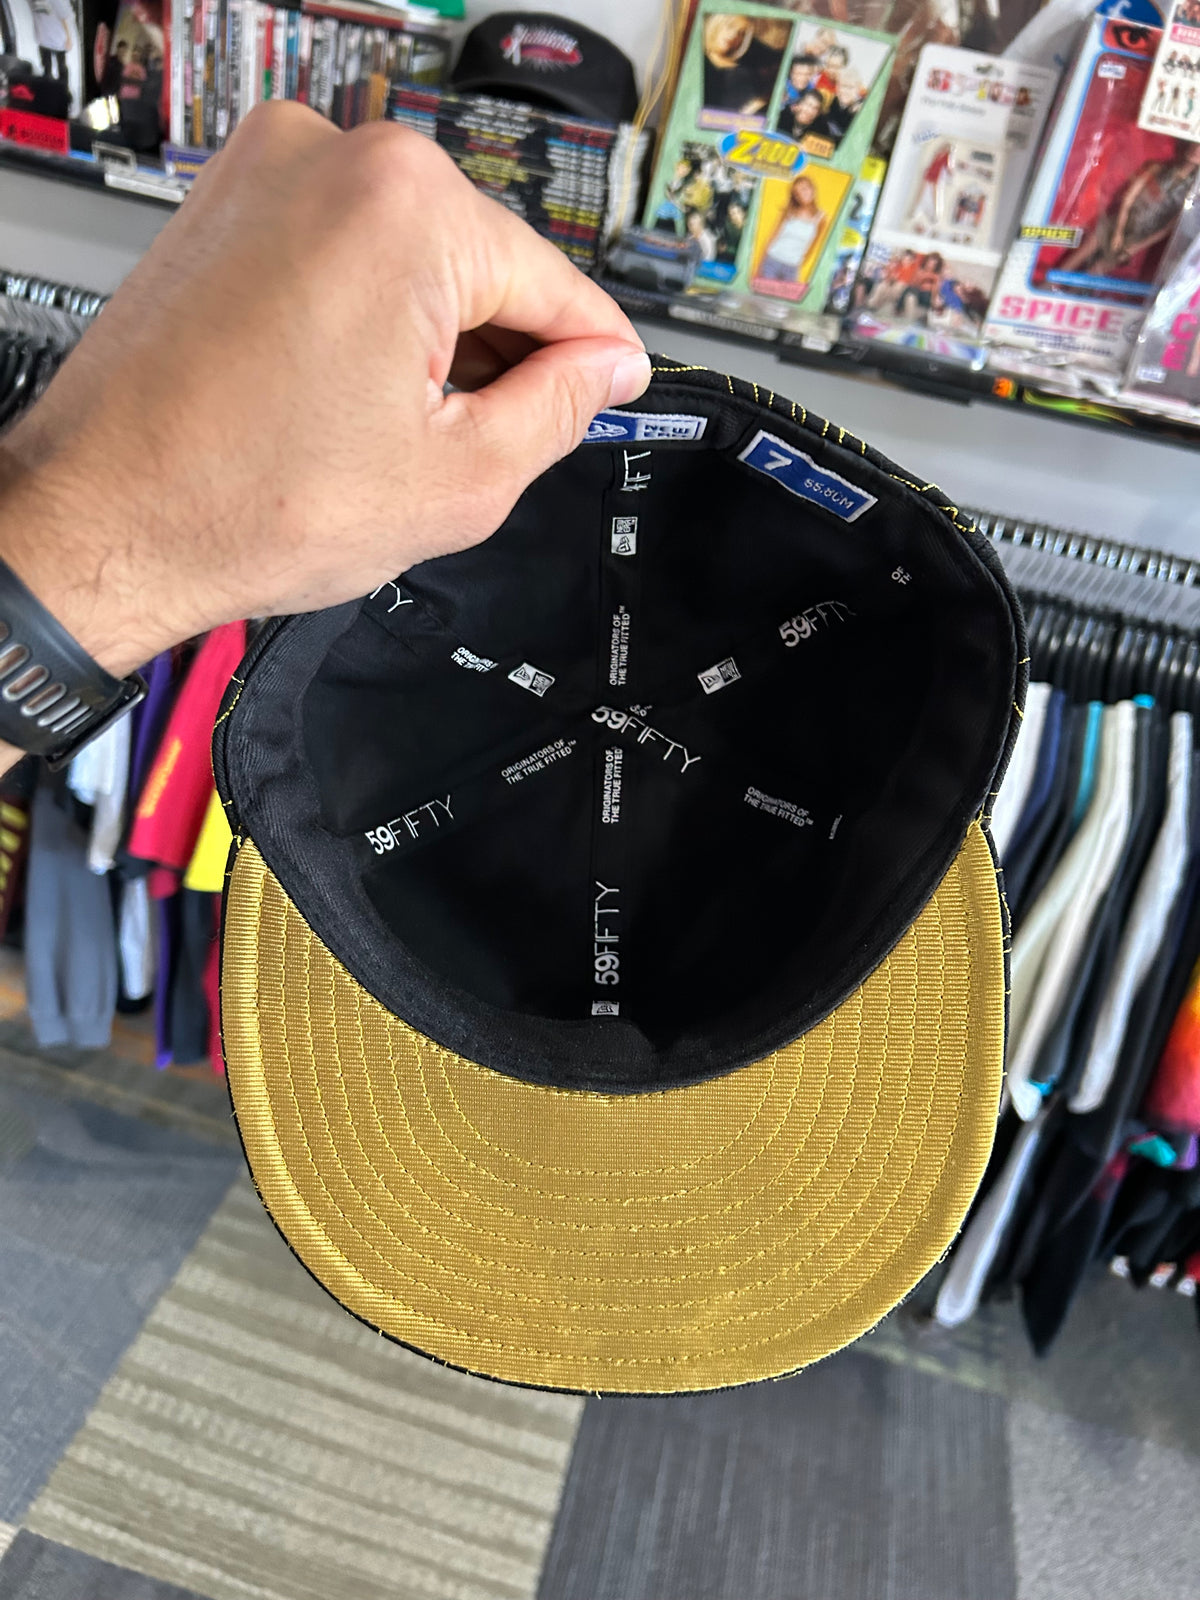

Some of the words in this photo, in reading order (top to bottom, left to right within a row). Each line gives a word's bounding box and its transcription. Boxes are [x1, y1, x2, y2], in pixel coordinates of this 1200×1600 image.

[999, 296, 1124, 335] SPICE
[763, 450, 793, 472] 7
[613, 614, 621, 628] OF
[451, 652, 466, 667] THE
[609, 628, 620, 686] ORIGINATORS
[619, 644, 628, 669] TRUE
[618, 669, 627, 687] THE
[591, 706, 701, 773] 59FIFTY
[501, 744, 555, 778] ORIGINATORS
[552, 738, 566, 750] OF
[605, 749, 614, 762] OF
[506, 770, 524, 785] THE
[523, 760, 546, 777] TRUE
[602, 763, 614, 824] ORIGINATORS
[612, 779, 621, 804] TRUE
[743, 794, 760, 809] THE
[364, 794, 455, 855] 59FIFTY
[611, 805, 620, 824] THE
[796, 807, 811, 819] OF
[594, 880, 620, 985] 59FIFTY
